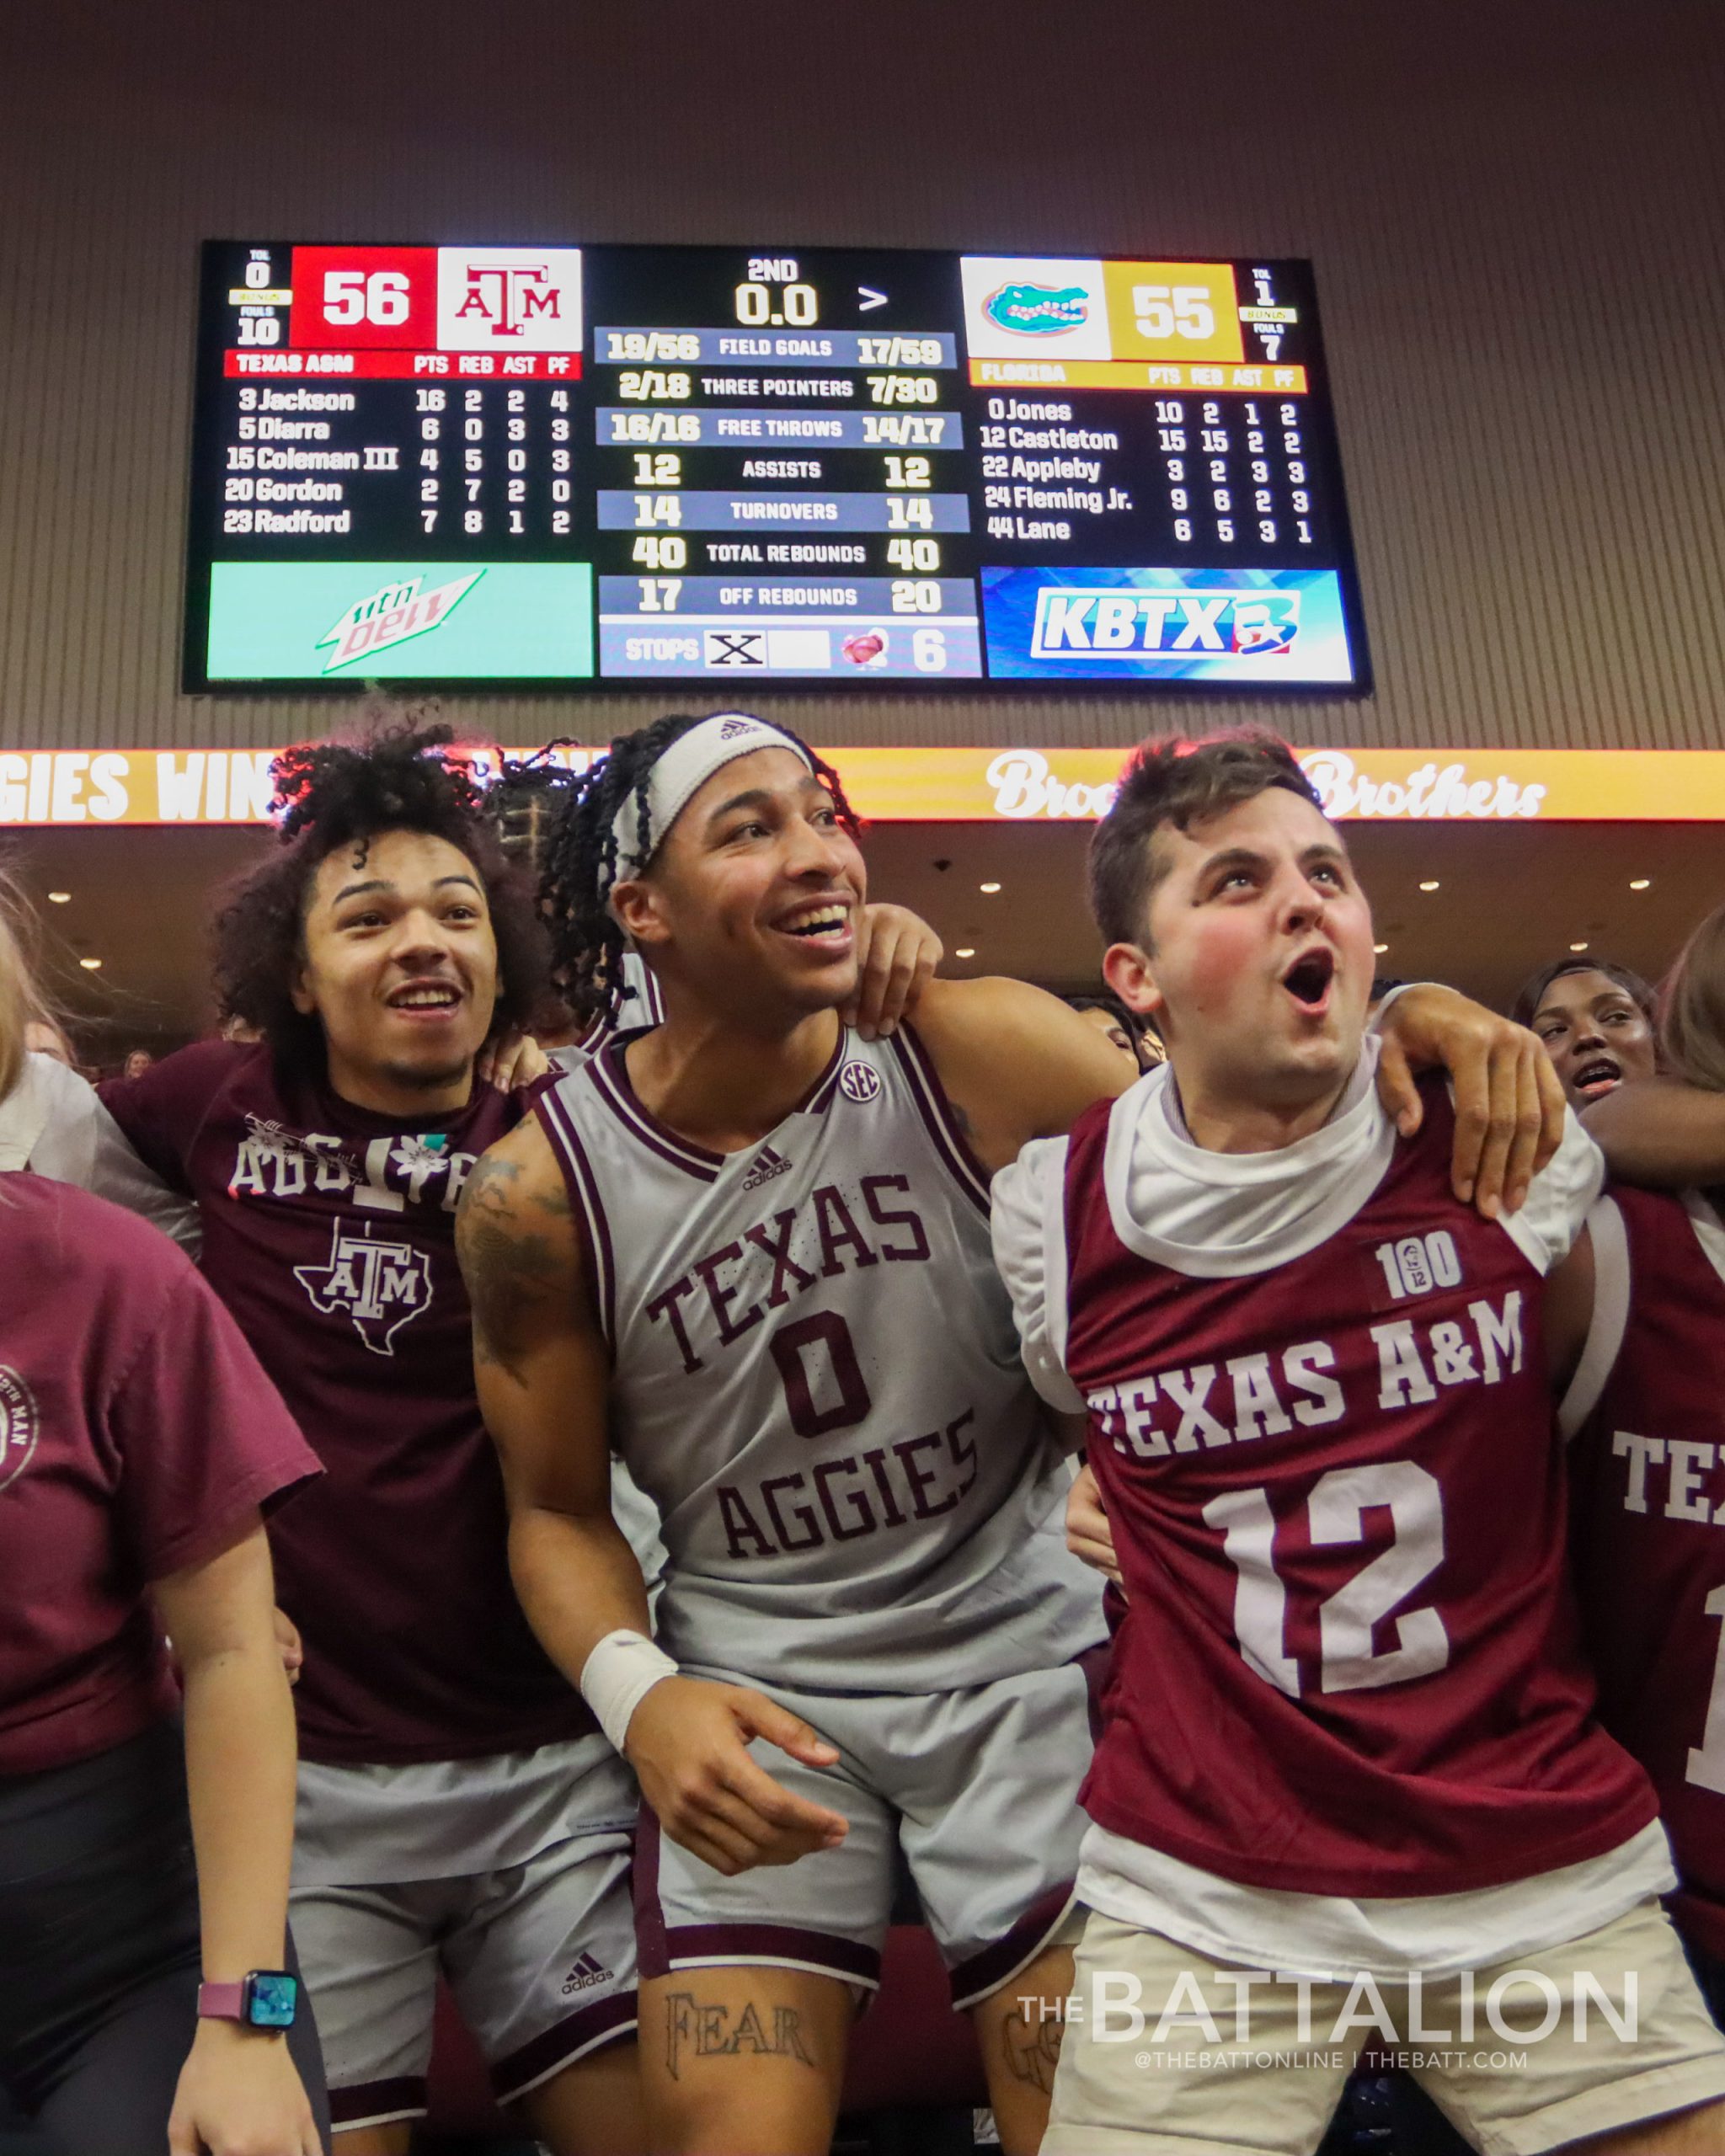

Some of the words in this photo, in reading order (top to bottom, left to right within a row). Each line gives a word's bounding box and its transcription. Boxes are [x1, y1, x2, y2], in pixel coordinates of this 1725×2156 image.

[246, 262, 270, 288] 0
[748, 259, 798, 282] 2ND
[323, 272, 409, 325] 56
[734, 283, 818, 326] 0.0
[1254, 280, 1274, 306] 1
[1132, 285, 1215, 339] 55
[238, 318, 280, 344] 10
[1260, 335, 1280, 361] 7
[237, 355, 301, 371] TEXAS
[414, 355, 448, 373] PTS
[459, 356, 494, 374] REB
[503, 356, 536, 374] AST
[548, 356, 569, 374] PF
[607, 332, 700, 361] 19/56
[719, 339, 772, 355] FIELD
[775, 340, 833, 356] GOALS
[857, 338, 943, 366] 17/59
[619, 371, 691, 400] 2/18
[702, 379, 760, 396] THREE
[763, 379, 854, 398] POINTERS
[866, 376, 937, 404] 7/30
[981, 363, 1067, 383] FLORIDA
[1148, 367, 1181, 386] PTS
[1190, 368, 1223, 387] REB
[1232, 369, 1263, 387] AST
[1274, 369, 1295, 387] PF
[239, 389, 255, 410] 3
[259, 389, 355, 411] Jackson
[416, 389, 446, 411] 16
[465, 390, 482, 412] 2
[508, 390, 524, 412] 2
[551, 390, 569, 412] 4
[988, 398, 1004, 420] 0
[1007, 399, 1072, 421] Jones
[1156, 402, 1183, 424] 10
[1203, 403, 1220, 424] 2
[1245, 403, 1259, 424] 1
[1280, 404, 1297, 426] 2
[239, 418, 254, 440] 5
[259, 418, 329, 440] Diarra
[422, 418, 440, 440] 6
[465, 419, 482, 440] 0
[508, 419, 526, 440] 3
[552, 419, 569, 441] 3
[611, 412, 701, 443] 16/16
[718, 419, 762, 436] FREE
[765, 420, 843, 437] THROWS
[862, 415, 945, 445] 14/17
[980, 427, 1006, 449] 12
[1009, 428, 1119, 451] Castleton
[1158, 430, 1186, 452] 15
[1201, 430, 1228, 452] 15
[1248, 431, 1264, 453] 2
[1284, 432, 1300, 454] 2
[227, 447, 254, 470] 15
[257, 447, 359, 470] Coleman
[363, 447, 399, 471] III
[420, 449, 438, 471] 4
[465, 450, 482, 472] 5
[508, 450, 526, 472] 0
[552, 450, 569, 472] 3
[633, 453, 681, 486] 12
[742, 461, 822, 478] ASSISTS
[884, 456, 932, 488] 12
[982, 456, 1008, 478] 22
[1012, 456, 1101, 483] Appleby
[1167, 459, 1184, 482] 3
[1210, 460, 1226, 482] 2
[1252, 460, 1268, 483] 3
[1288, 461, 1306, 483] 3
[225, 478, 253, 501] 20
[255, 478, 342, 501] Gordon
[421, 478, 439, 501] 2
[465, 479, 482, 501] 7
[508, 479, 526, 501] 2
[553, 479, 569, 501] 0
[985, 486, 1011, 507] 24
[1013, 486, 1103, 515] Fleming
[1107, 488, 1132, 510] Jr.
[1171, 488, 1188, 511] 9
[1214, 489, 1231, 512] 6
[1255, 490, 1271, 512] 2
[1291, 490, 1309, 513] 3
[224, 510, 253, 532] 23
[255, 510, 350, 533] Radford
[421, 510, 438, 532] 7
[465, 510, 483, 532] 8
[509, 510, 524, 533] 1
[553, 510, 569, 533] 2
[634, 494, 682, 527] 14
[730, 502, 838, 520] TURNOVERS
[886, 498, 933, 529] 14
[987, 516, 1014, 538] 44
[1016, 517, 1071, 540] Lane
[1174, 520, 1192, 542] 6
[1217, 520, 1235, 542] 5
[1259, 520, 1277, 543] 3
[1297, 522, 1312, 543] 1
[633, 536, 686, 569] 40
[707, 544, 764, 563] TOTAL
[767, 546, 866, 563] REBOUNDS
[886, 538, 940, 571] 40
[638, 579, 683, 611] 17
[720, 588, 754, 606] OFF
[759, 588, 857, 606] REBOUNDS
[890, 580, 943, 613] 20
[1044, 597, 1231, 650] KBTX
[626, 638, 700, 661] STOPS
[912, 628, 947, 672] 6
[843, 1063, 879, 1097] SEC
[742, 1158, 792, 1192] adidas
[645, 1174, 931, 1374] TEXAS
[1375, 1230, 1462, 1299] 100
[770, 1310, 871, 1438] 0
[1087, 1340, 1346, 1457] TEXAS
[1370, 1291, 1522, 1410] A&M
[10, 1405, 29, 1445] MAN
[718, 1408, 978, 1559] AGGIES
[1612, 1431, 1725, 1525] TE
[1202, 1460, 1450, 1699] 12
[561, 1969, 615, 1995] adidas
[665, 1993, 815, 2080] FEAR
